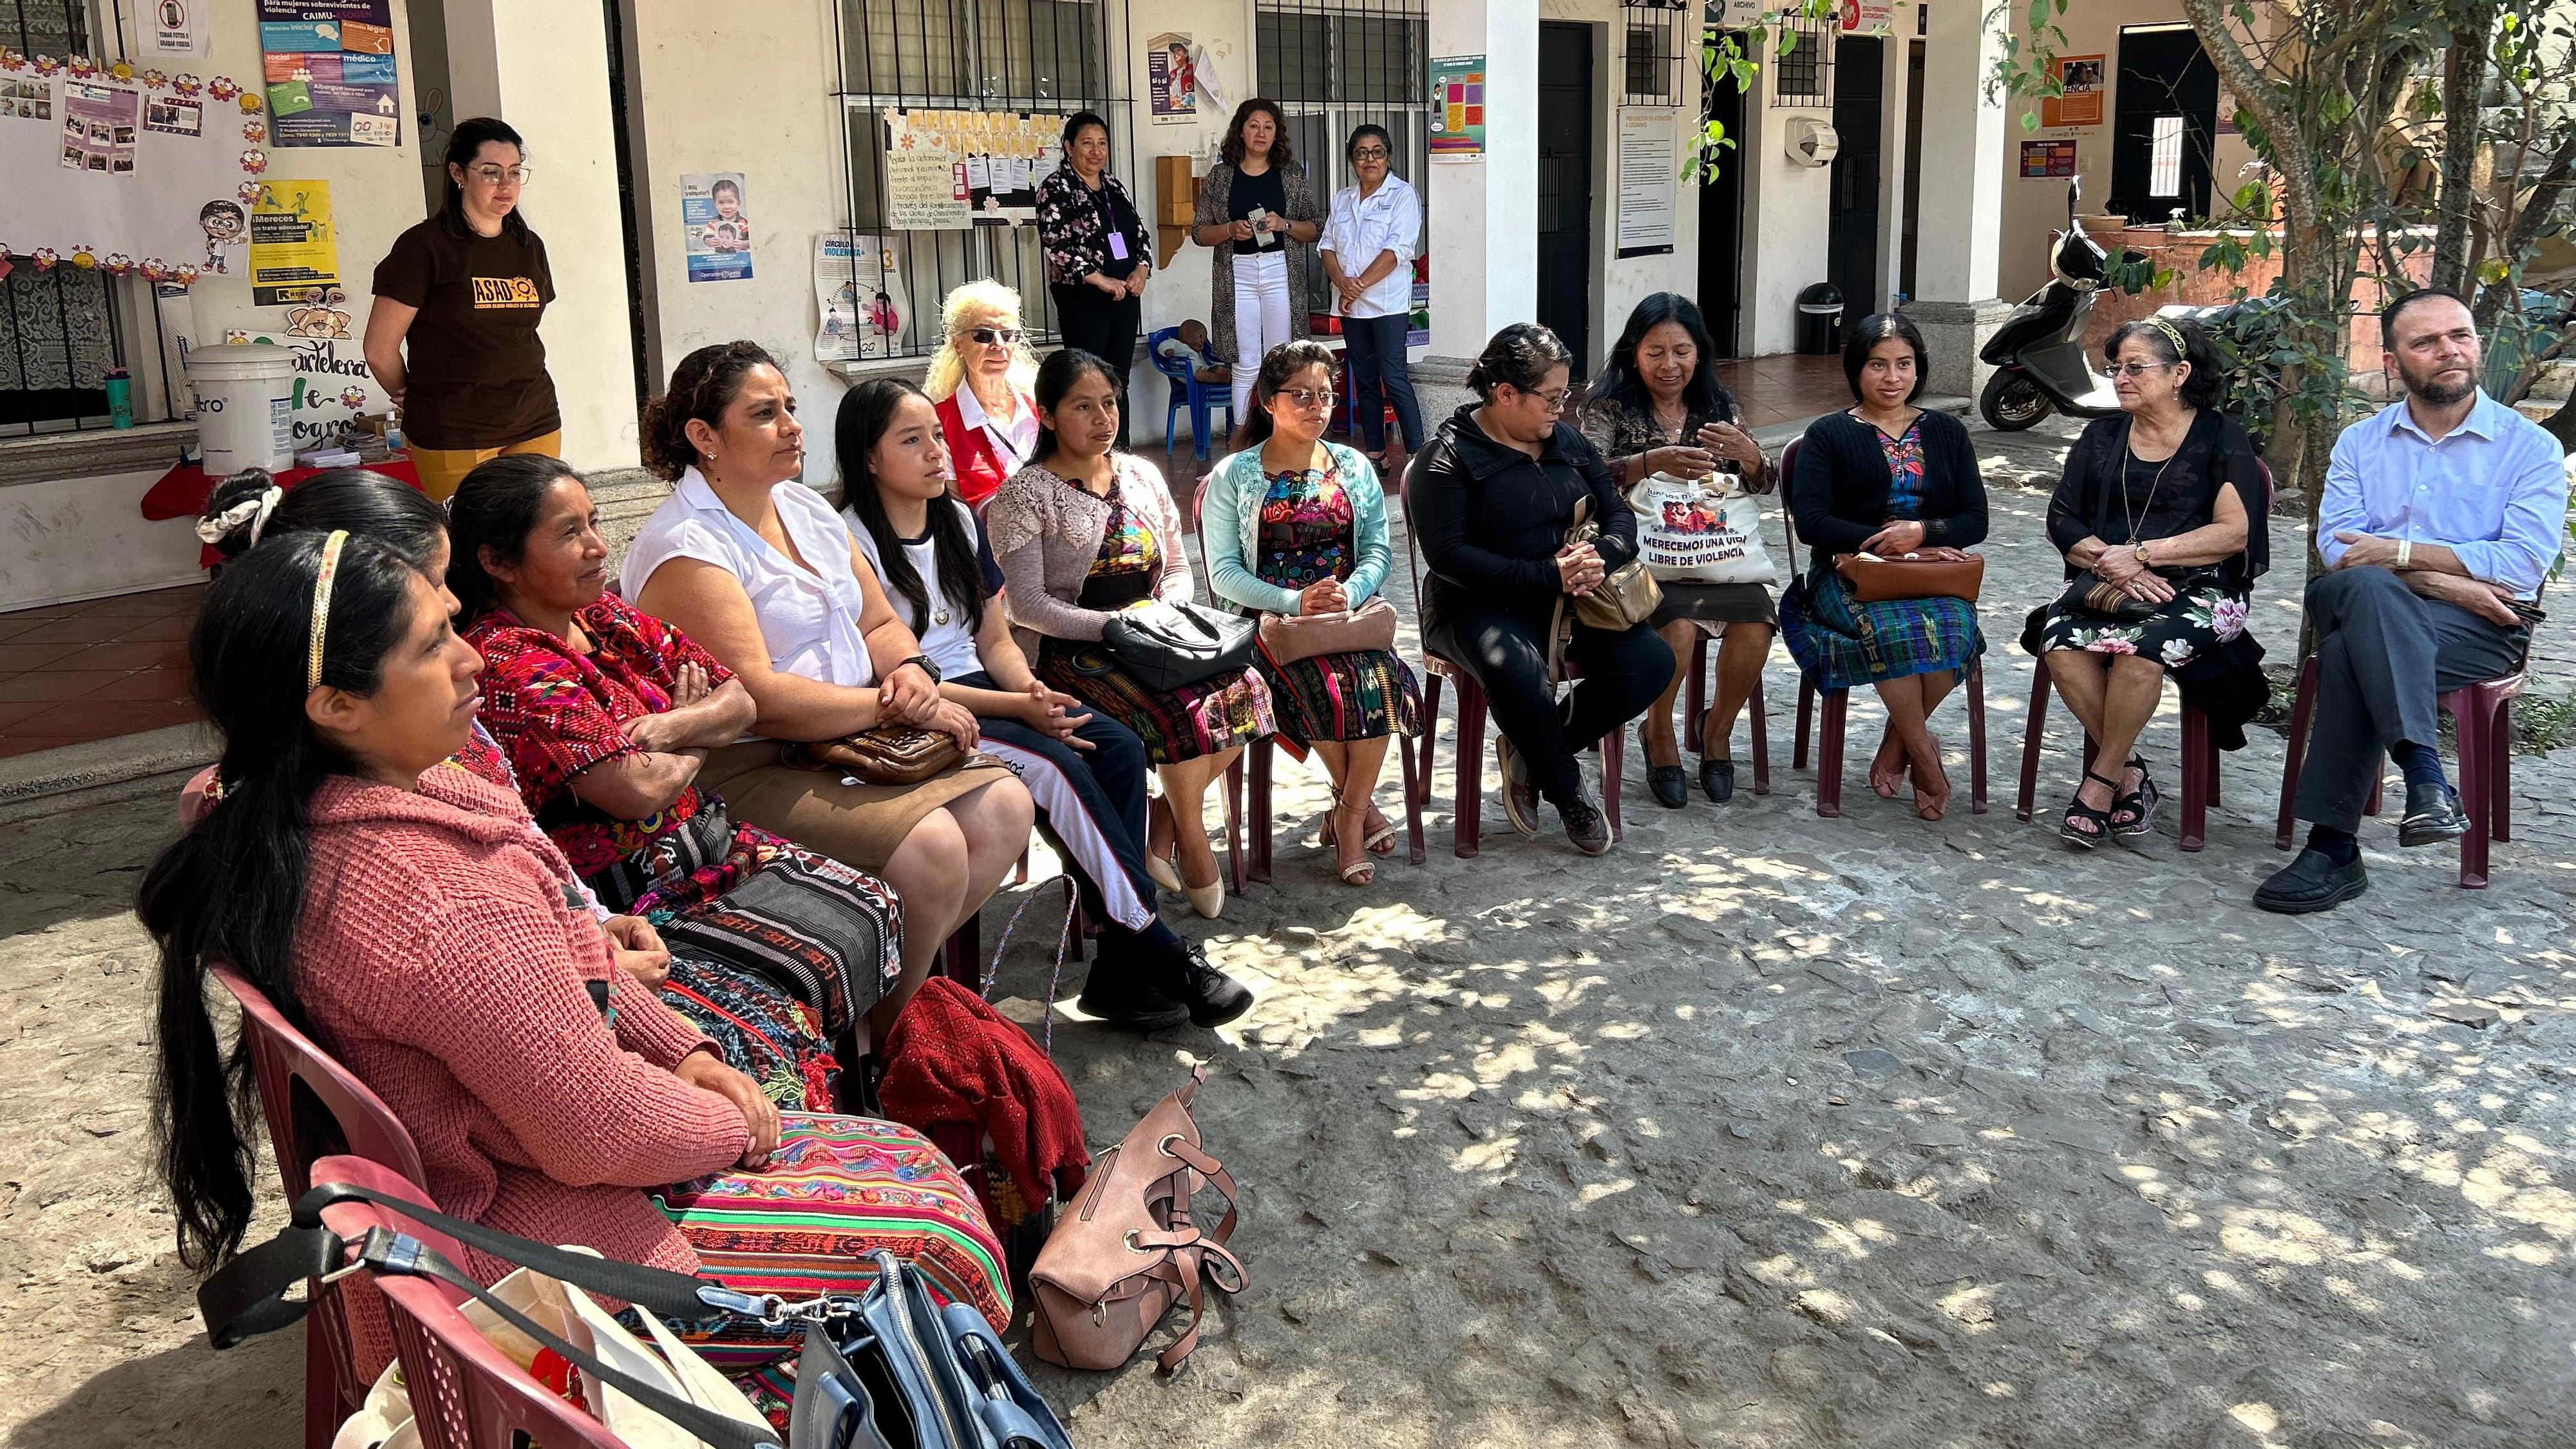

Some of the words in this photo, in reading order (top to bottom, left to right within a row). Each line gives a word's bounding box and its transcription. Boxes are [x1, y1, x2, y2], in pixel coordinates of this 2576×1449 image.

[366, 24, 386, 33] legal
[343, 54, 376, 62] médico
[825, 240, 850, 248] CÍRCULO
[883, 249, 893, 269] 3
[1643, 535, 1704, 552] MERECEMOS
[1706, 536, 1724, 548] UNA
[1648, 551, 1677, 566] LIBRE
[1680, 555, 1693, 566] DE
[1696, 547, 1745, 564] VIOLENCIA
